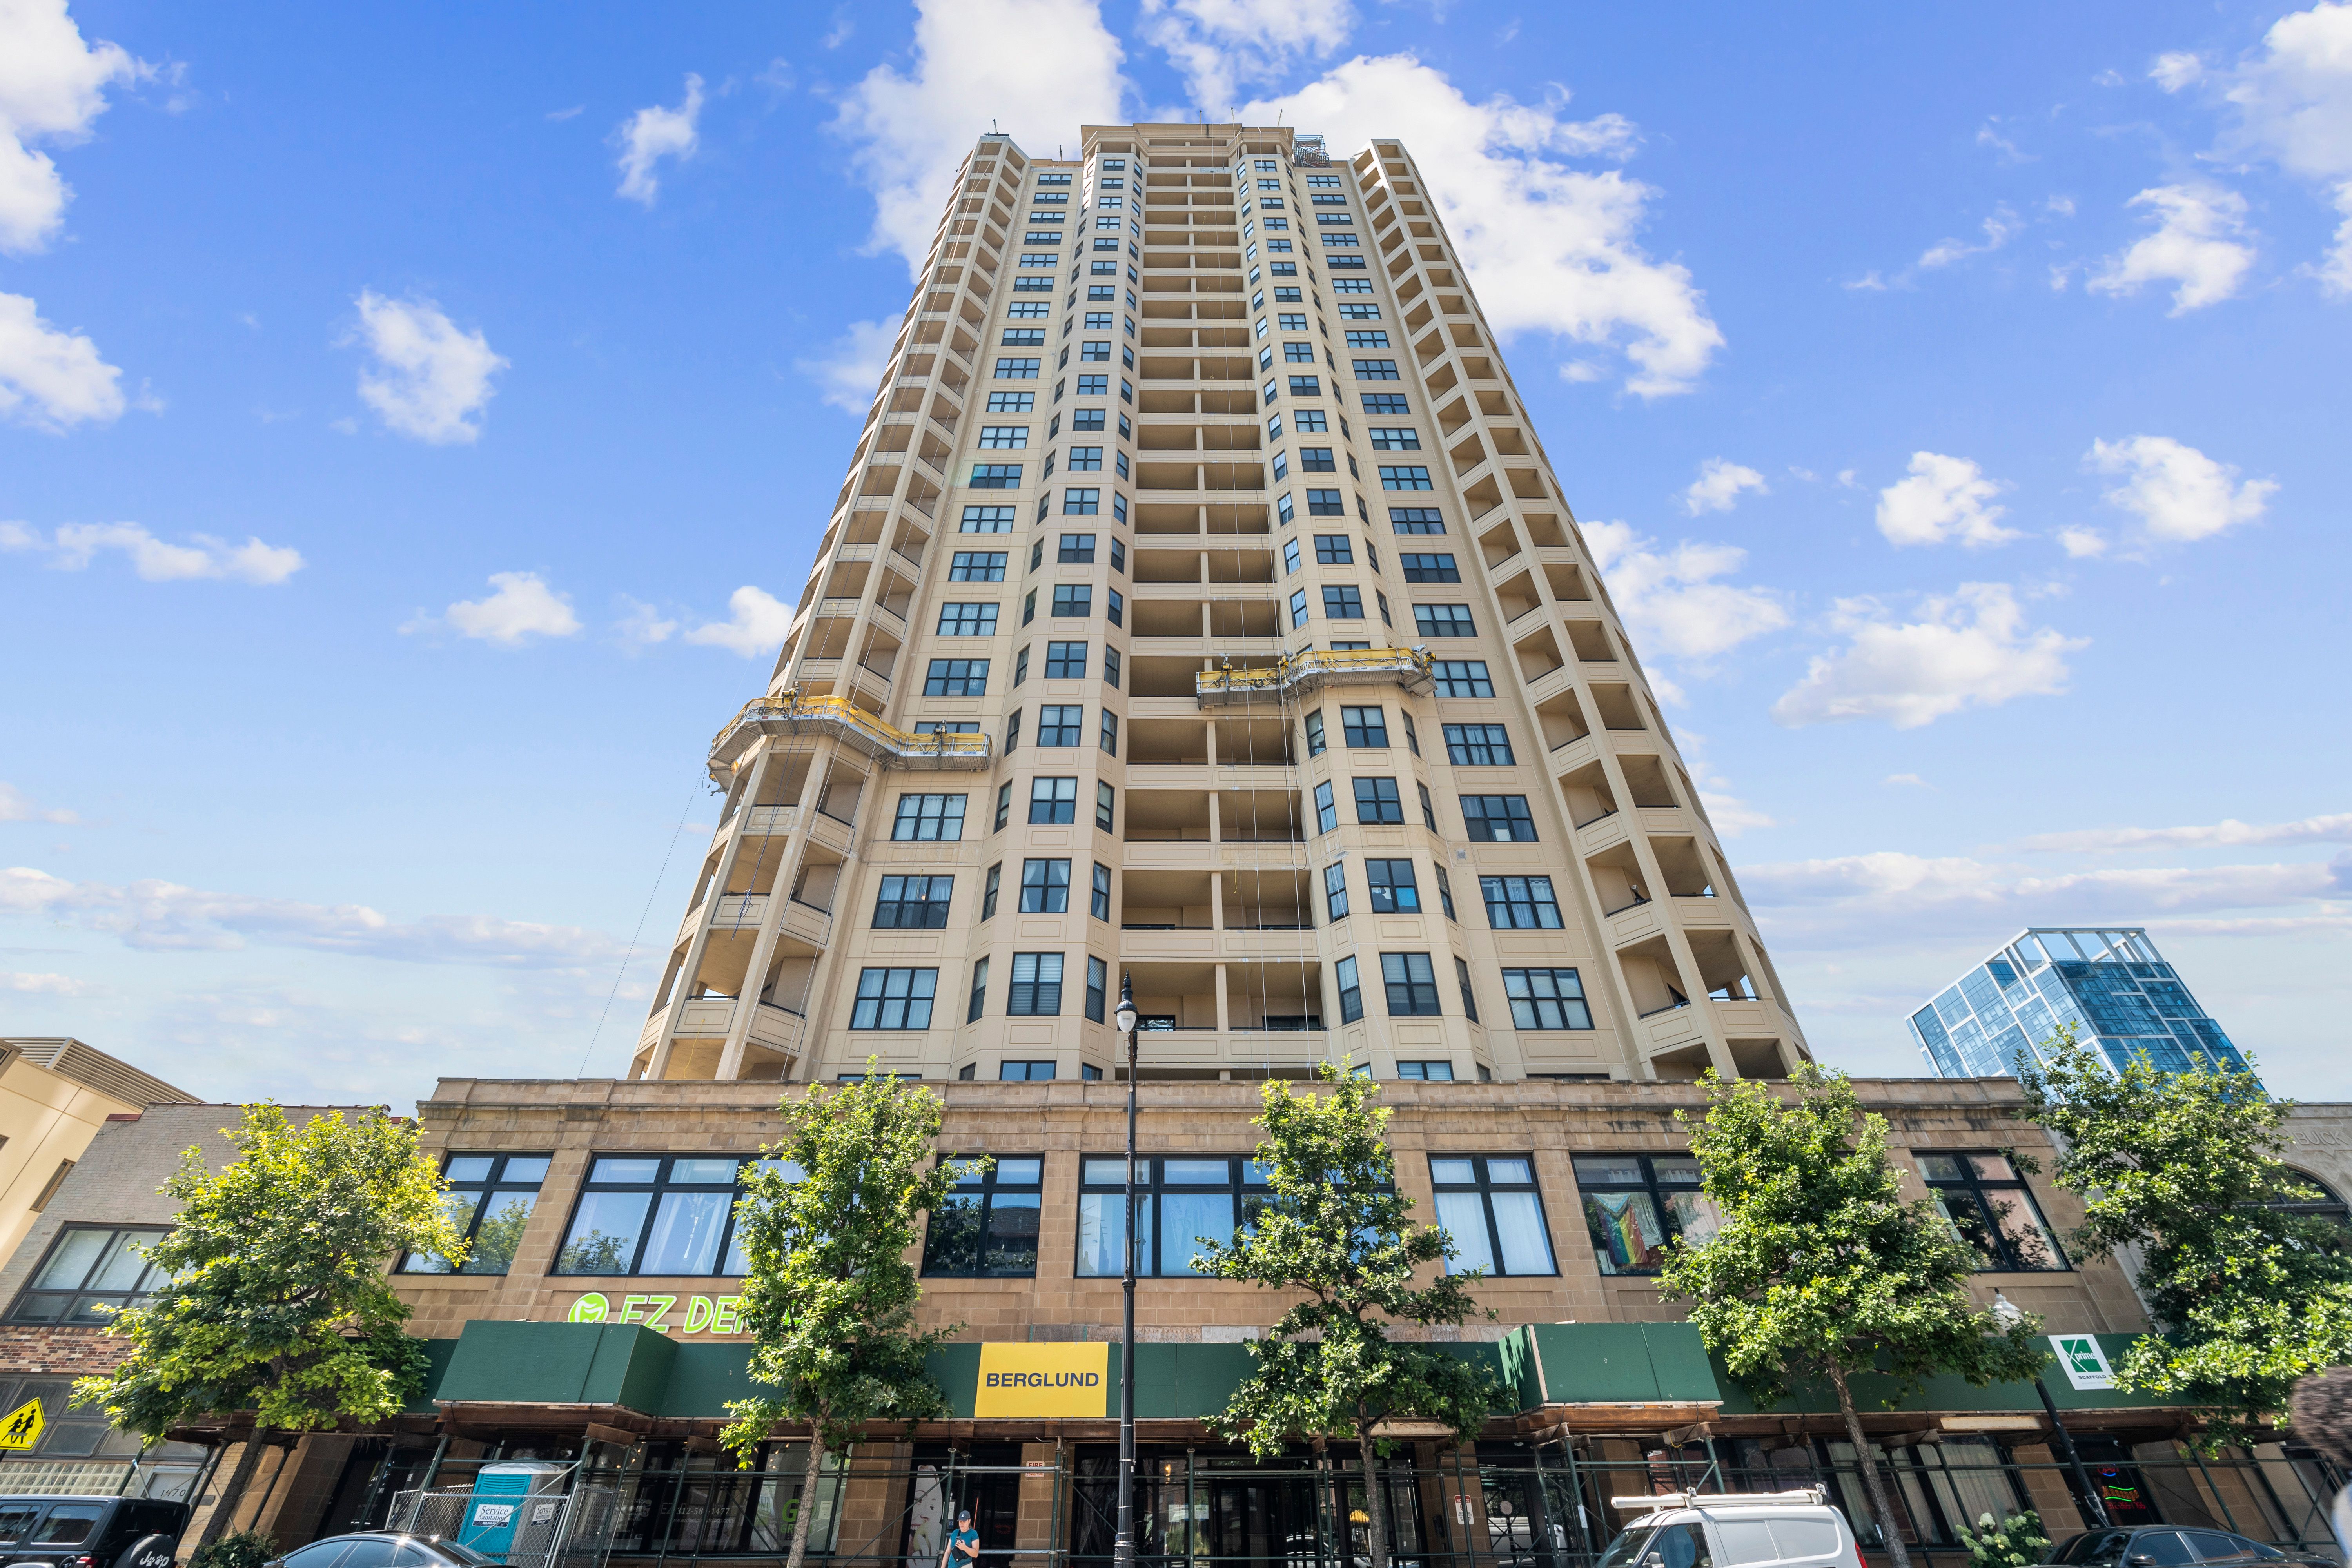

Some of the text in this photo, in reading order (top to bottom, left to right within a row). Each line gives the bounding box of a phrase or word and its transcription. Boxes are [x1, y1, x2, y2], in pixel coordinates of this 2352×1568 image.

[2292, 1131, 2348, 1145] BUICK
[619, 1295, 677, 1334] EZ
[2074, 1351, 2097, 1362] prime
[986, 1373, 1099, 1387] BERGLUND
[481, 1506, 508, 1515] Service
[537, 1505, 552, 1514] Service
